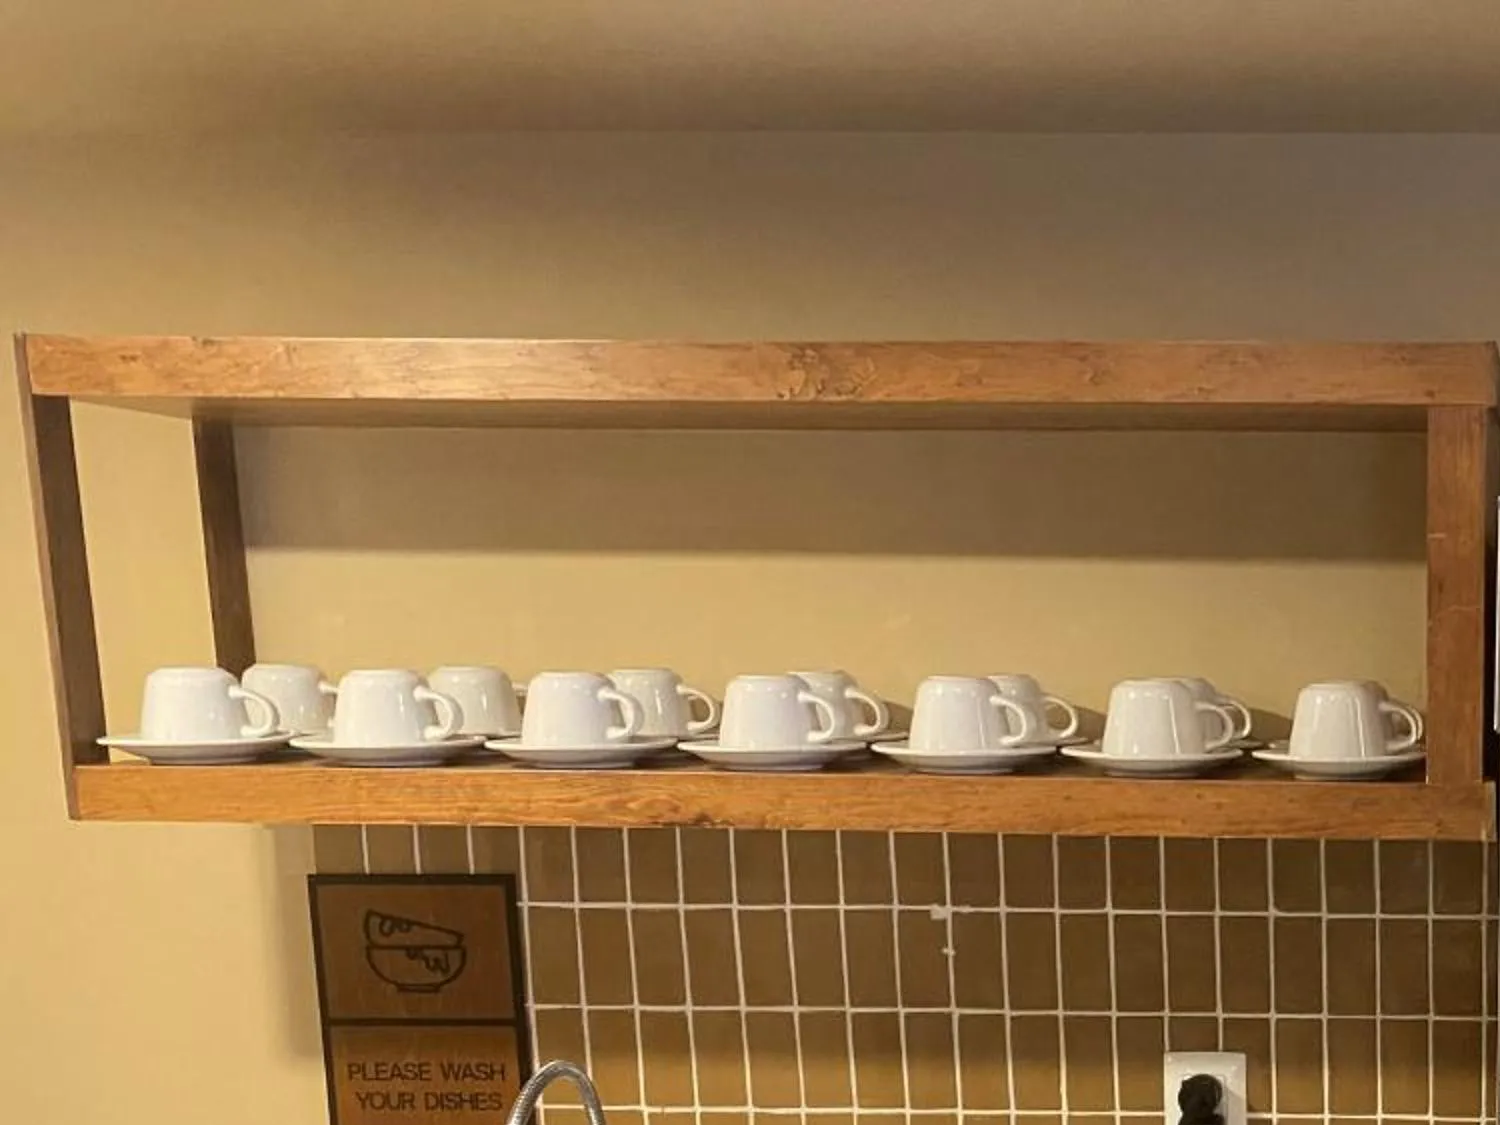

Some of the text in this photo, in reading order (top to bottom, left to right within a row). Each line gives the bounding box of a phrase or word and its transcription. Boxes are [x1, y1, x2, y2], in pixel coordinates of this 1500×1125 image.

[347, 1062, 506, 1082] PLEASE WASH
[354, 1091, 503, 1111] YOUR DISHES
